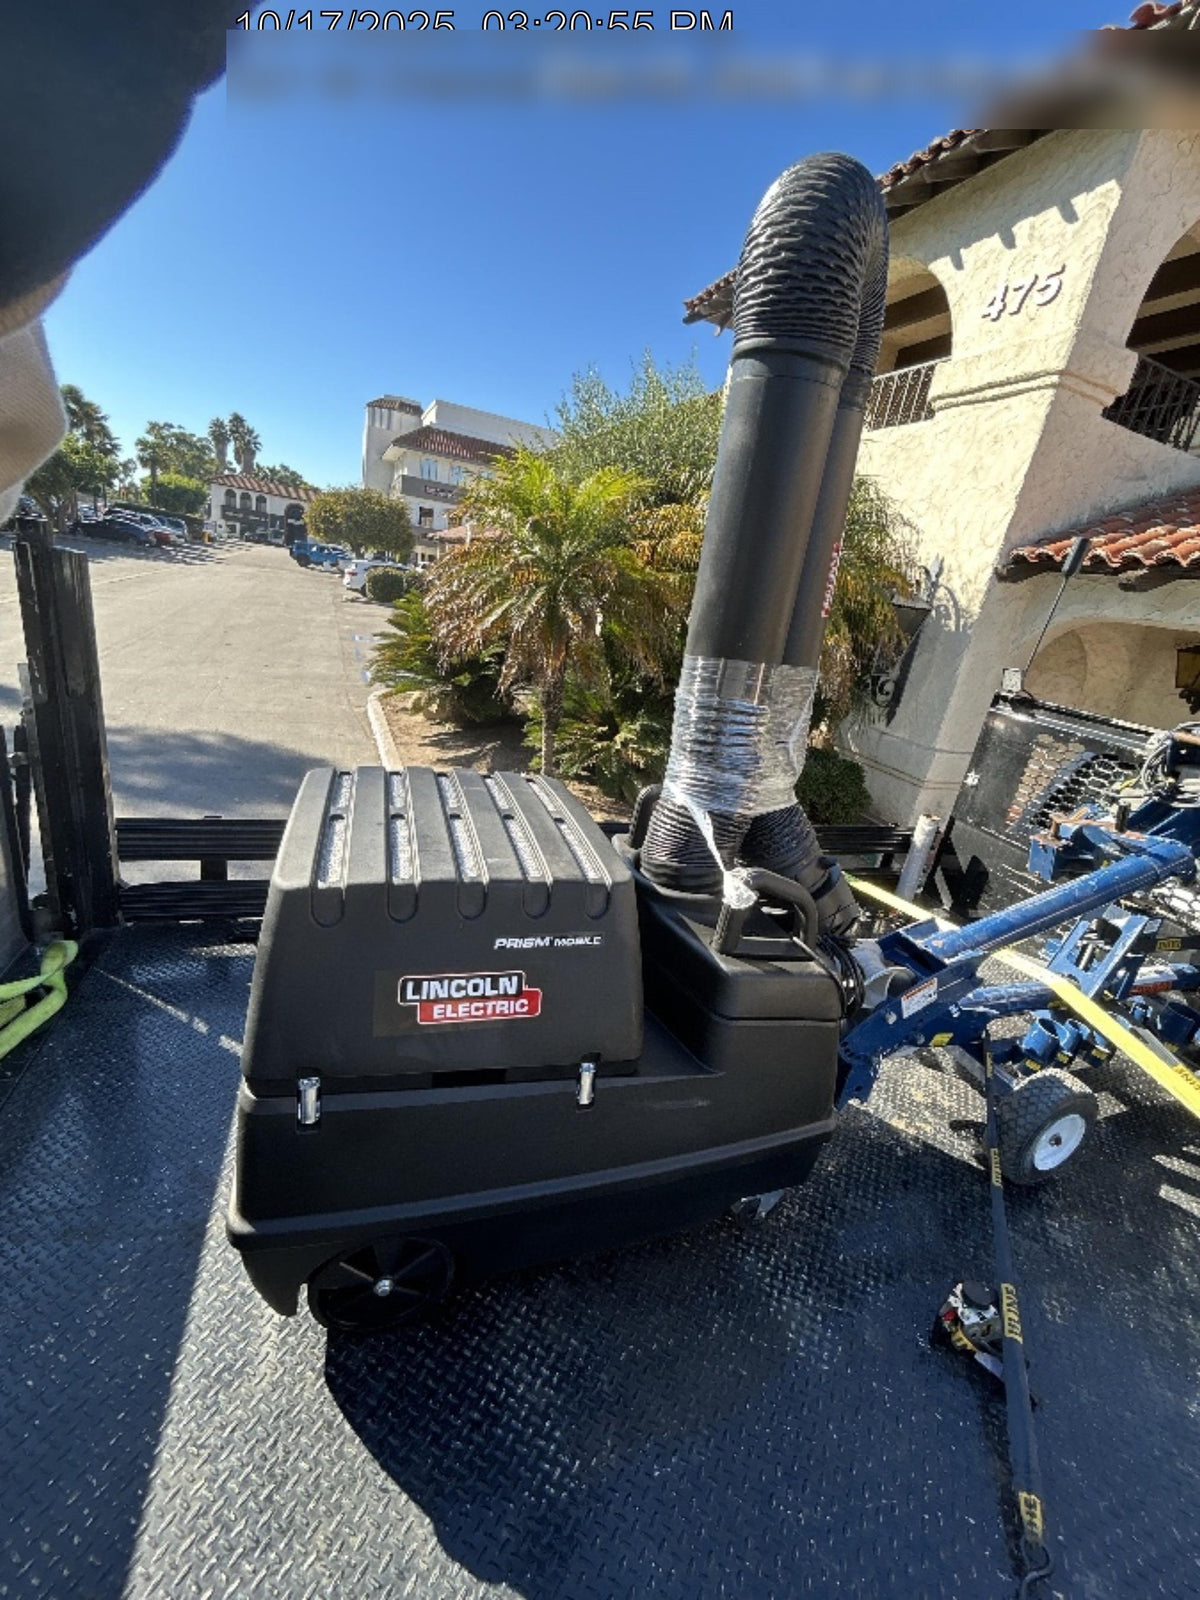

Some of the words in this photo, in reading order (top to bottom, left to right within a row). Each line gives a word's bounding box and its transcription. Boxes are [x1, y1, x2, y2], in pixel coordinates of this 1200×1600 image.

[978, 262, 1066, 322] 475
[493, 936, 550, 950] PRISM
[406, 975, 518, 1000] LINCOLN
[432, 998, 529, 1020] ELECTRIC
